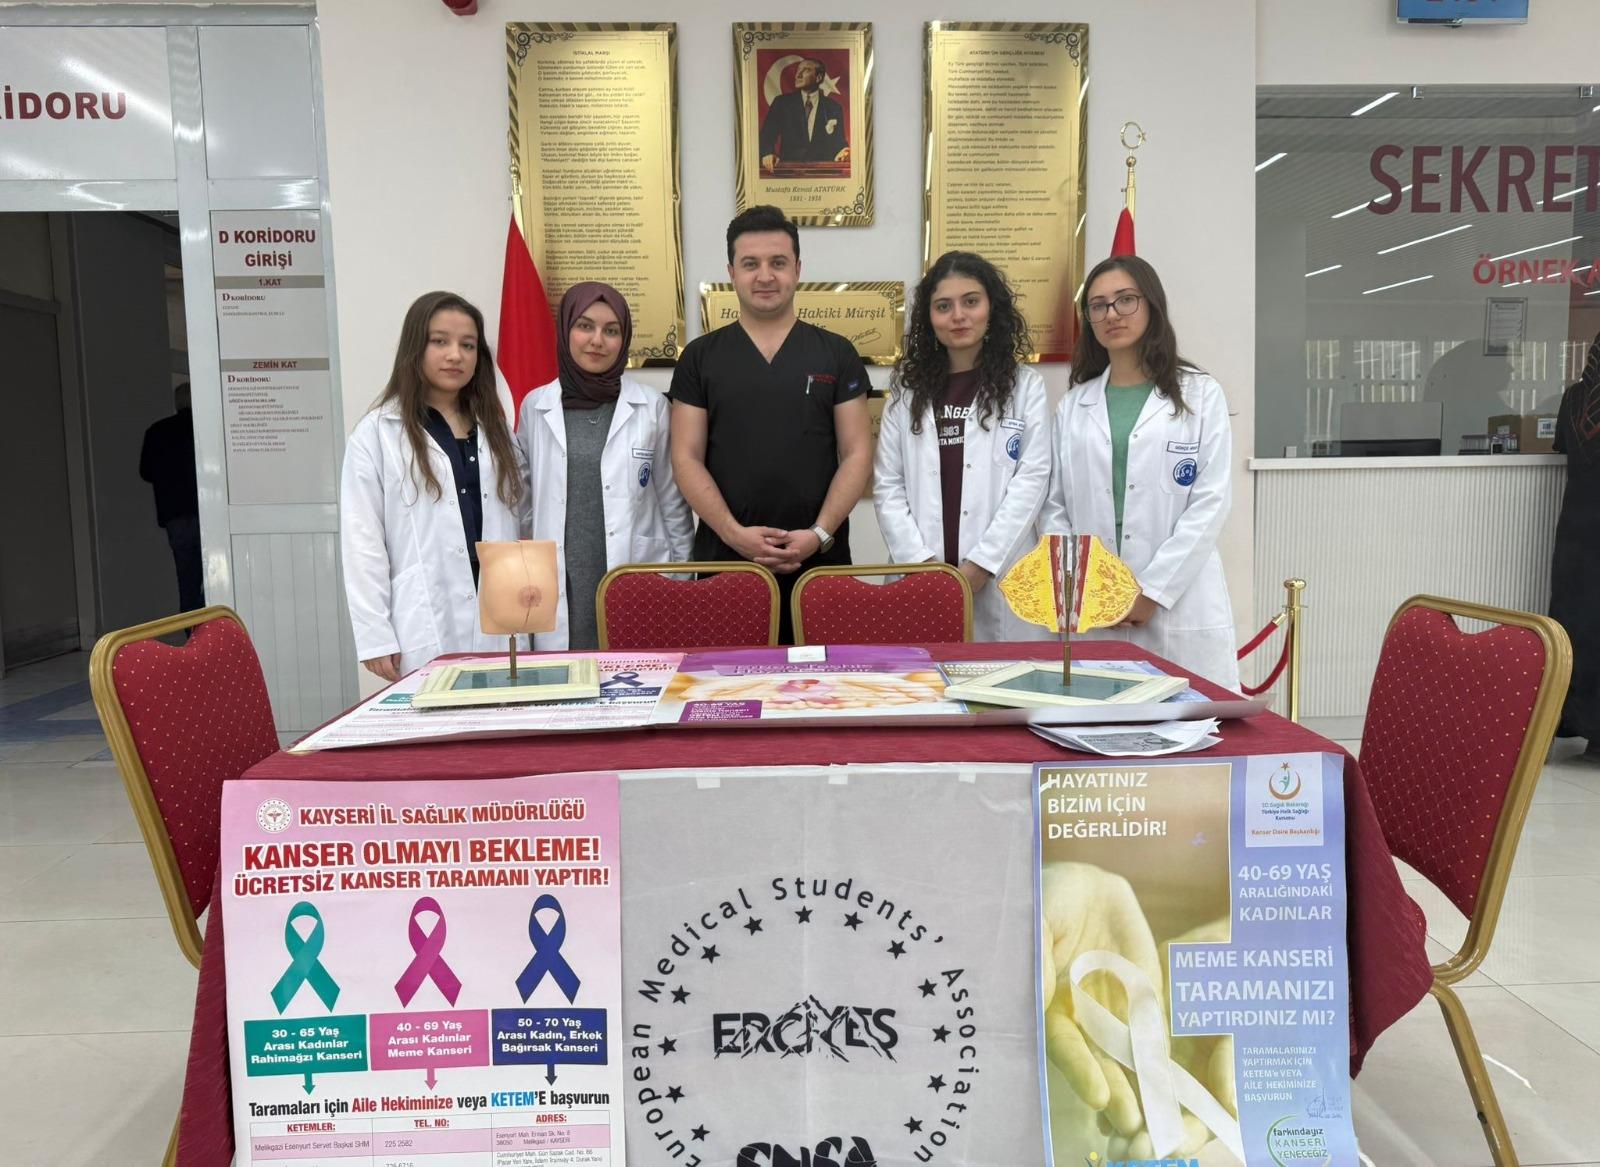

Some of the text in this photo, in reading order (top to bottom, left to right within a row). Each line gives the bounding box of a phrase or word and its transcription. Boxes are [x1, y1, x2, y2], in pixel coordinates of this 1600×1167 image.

[0, 85, 126, 119] İDORU
[1366, 144, 1600, 215] SEKRET
[219, 227, 316, 243] D KORİDORU
[245, 251, 292, 270] GİRİŞİ
[1473, 253, 1586, 285] ÖRNEK
[222, 293, 230, 301] D
[797, 308, 841, 319] Hakiki
[845, 308, 886, 322] Mürşit
[253, 360, 278, 368] ZEMİN
[1048, 772, 1148, 789] HAYATINIZ
[1048, 793, 1145, 816] BİZİM İÇİN
[300, 800, 584, 824] KAYSERİ İL SAĞLIK MÜDÜRLÜĞÜ
[1049, 818, 1167, 839] DEĞERLİDİR!
[245, 838, 599, 870] KANSER OLMAYI BEKLEME!
[1238, 864, 1332, 883] 40-69 YAŞ
[235, 868, 609, 896] ÜCRETSİZ KANSER TARAMANI YAPTIR!
[1240, 884, 1332, 898] ARALIĞINDAKİ
[1240, 906, 1332, 921] KADINLAR
[1176, 946, 1333, 968] MEME KANSERİ
[1176, 980, 1334, 1002] TARAMANIZI
[518, 1019, 532, 1027] 50
[544, 1018, 559, 1027] 70
[563, 1018, 582, 1029] Yaş
[638, 888, 753, 1004] Medical
[914, 968, 980, 1163] Association
[1178, 1010, 1335, 1027] YAPTIRDINIZ MI?
[272, 1029, 287, 1039] 30
[300, 1028, 315, 1038] 65
[319, 1027, 339, 1038] Yaş
[397, 1023, 410, 1031] 40
[424, 1022, 438, 1030] 69
[443, 1021, 462, 1031] Yaş
[388, 1033, 471, 1045] Arası Kadınlar
[497, 1031, 602, 1041] Arası Kadın, Erkek
[264, 1040, 349, 1052] Arası Kadınlar
[388, 1045, 472, 1058] Meme Kanseri
[502, 1043, 598, 1054] Bağırsak Kanseri
[1242, 1047, 1316, 1055] TARAMALARINIZI
[251, 1051, 362, 1066] Rahimağzı Kanseri
[1242, 1057, 1312, 1067] YAPTIRMAK İÇİN
[1280, 1069, 1302, 1078] VEYA
[1244, 1080, 1316, 1090] AİLE HEKİMİNİZE
[249, 1091, 610, 1118] Taramaları için Aile Hekiminize veya KETEM'E başvurun
[1245, 1092, 1292, 1103] BAŞVURUN
[414, 1118, 449, 1130] TEL. NO:
[536, 1114, 567, 1123] ADRES:
[287, 1122, 335, 1133] KETEMLER:
[1273, 1128, 1324, 1136] farkındayız
